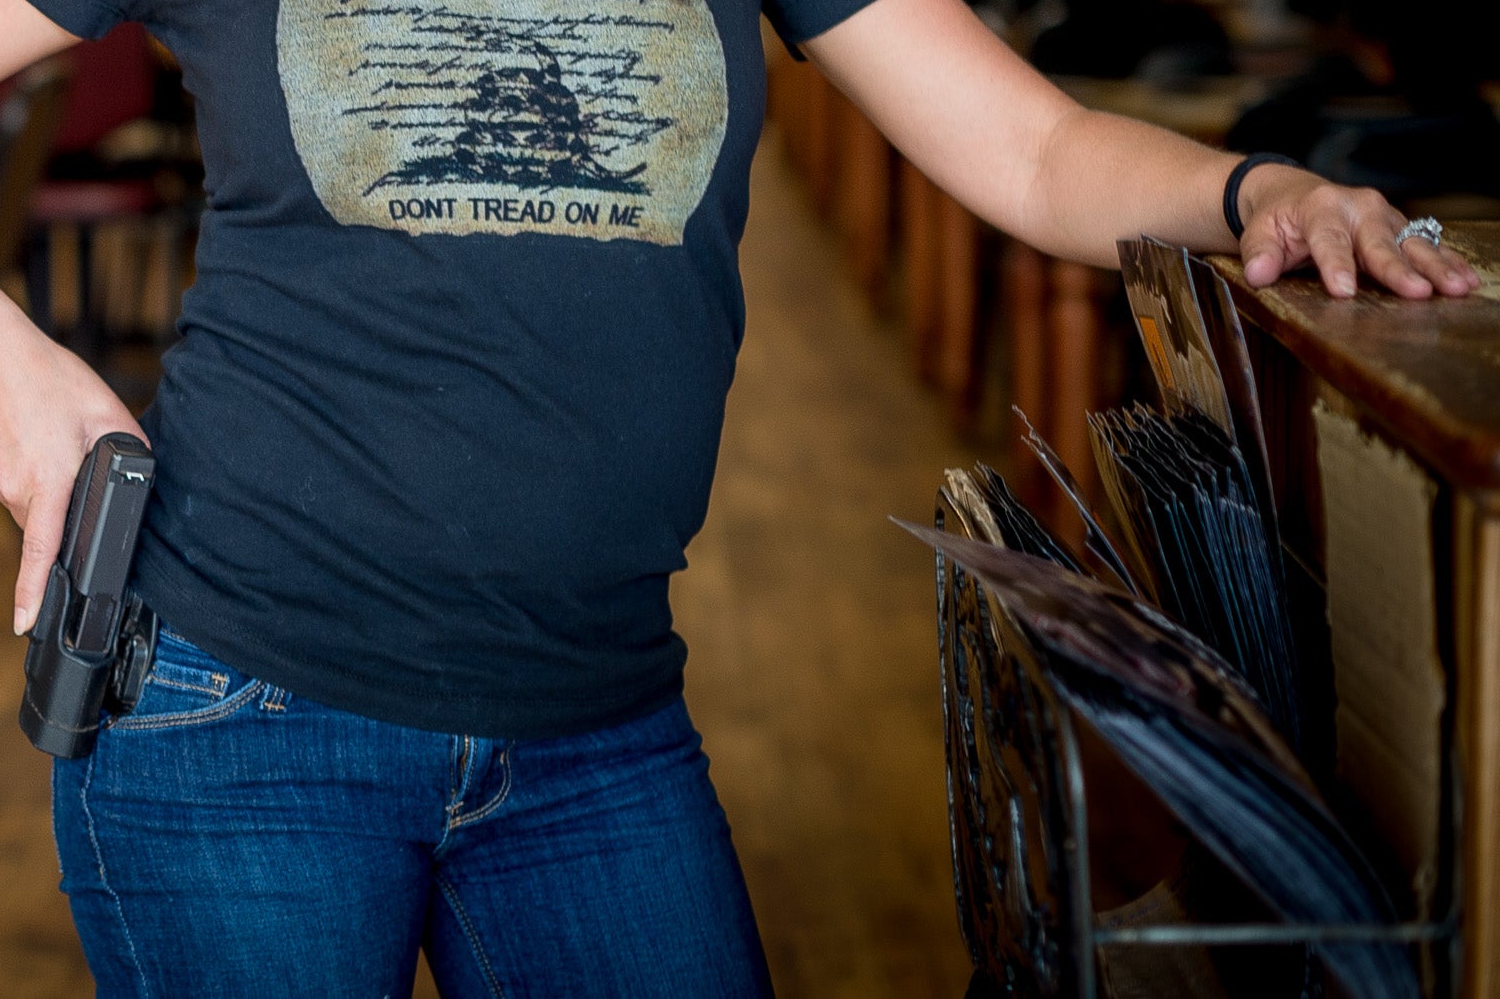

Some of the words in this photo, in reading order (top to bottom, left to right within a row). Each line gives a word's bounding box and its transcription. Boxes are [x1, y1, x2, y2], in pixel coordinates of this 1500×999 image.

[389, 198, 457, 221] DONT
[467, 197, 556, 224] TREAD
[564, 201, 600, 225] ON
[609, 203, 645, 228] ME
